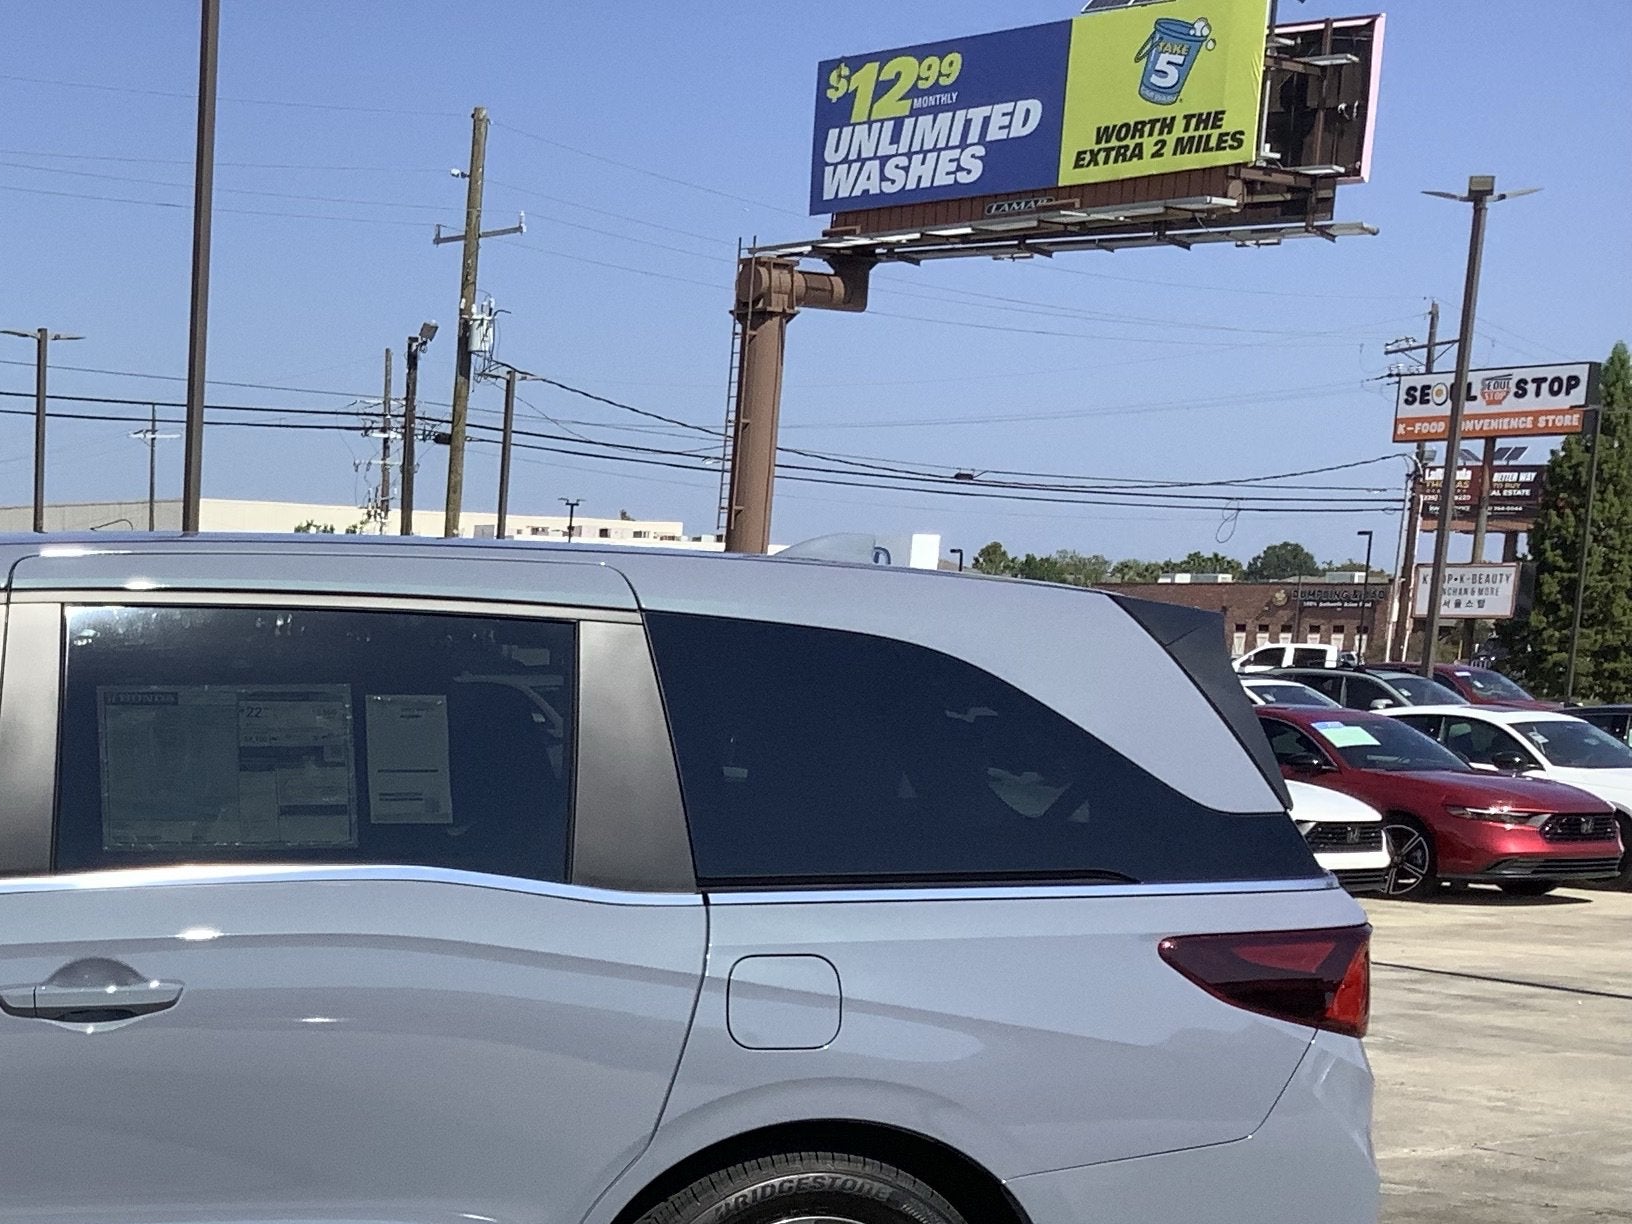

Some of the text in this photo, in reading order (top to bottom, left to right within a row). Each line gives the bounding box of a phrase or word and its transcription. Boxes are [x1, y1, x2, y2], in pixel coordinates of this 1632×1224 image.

[1158, 42, 1190, 55] TAKE
[1150, 53, 1186, 88] 5
[913, 91, 958, 109] MONTHLY
[823, 98, 1043, 164] UNLIMITED
[1094, 110, 1226, 146] WORTH THE
[1072, 130, 1246, 170] EXTRA 2 MILES
[822, 145, 986, 201] WASHES
[1404, 374, 1581, 406] SEOL STOP
[1397, 421, 1445, 435] K-FOOD
[1537, 413, 1581, 427] STORE
